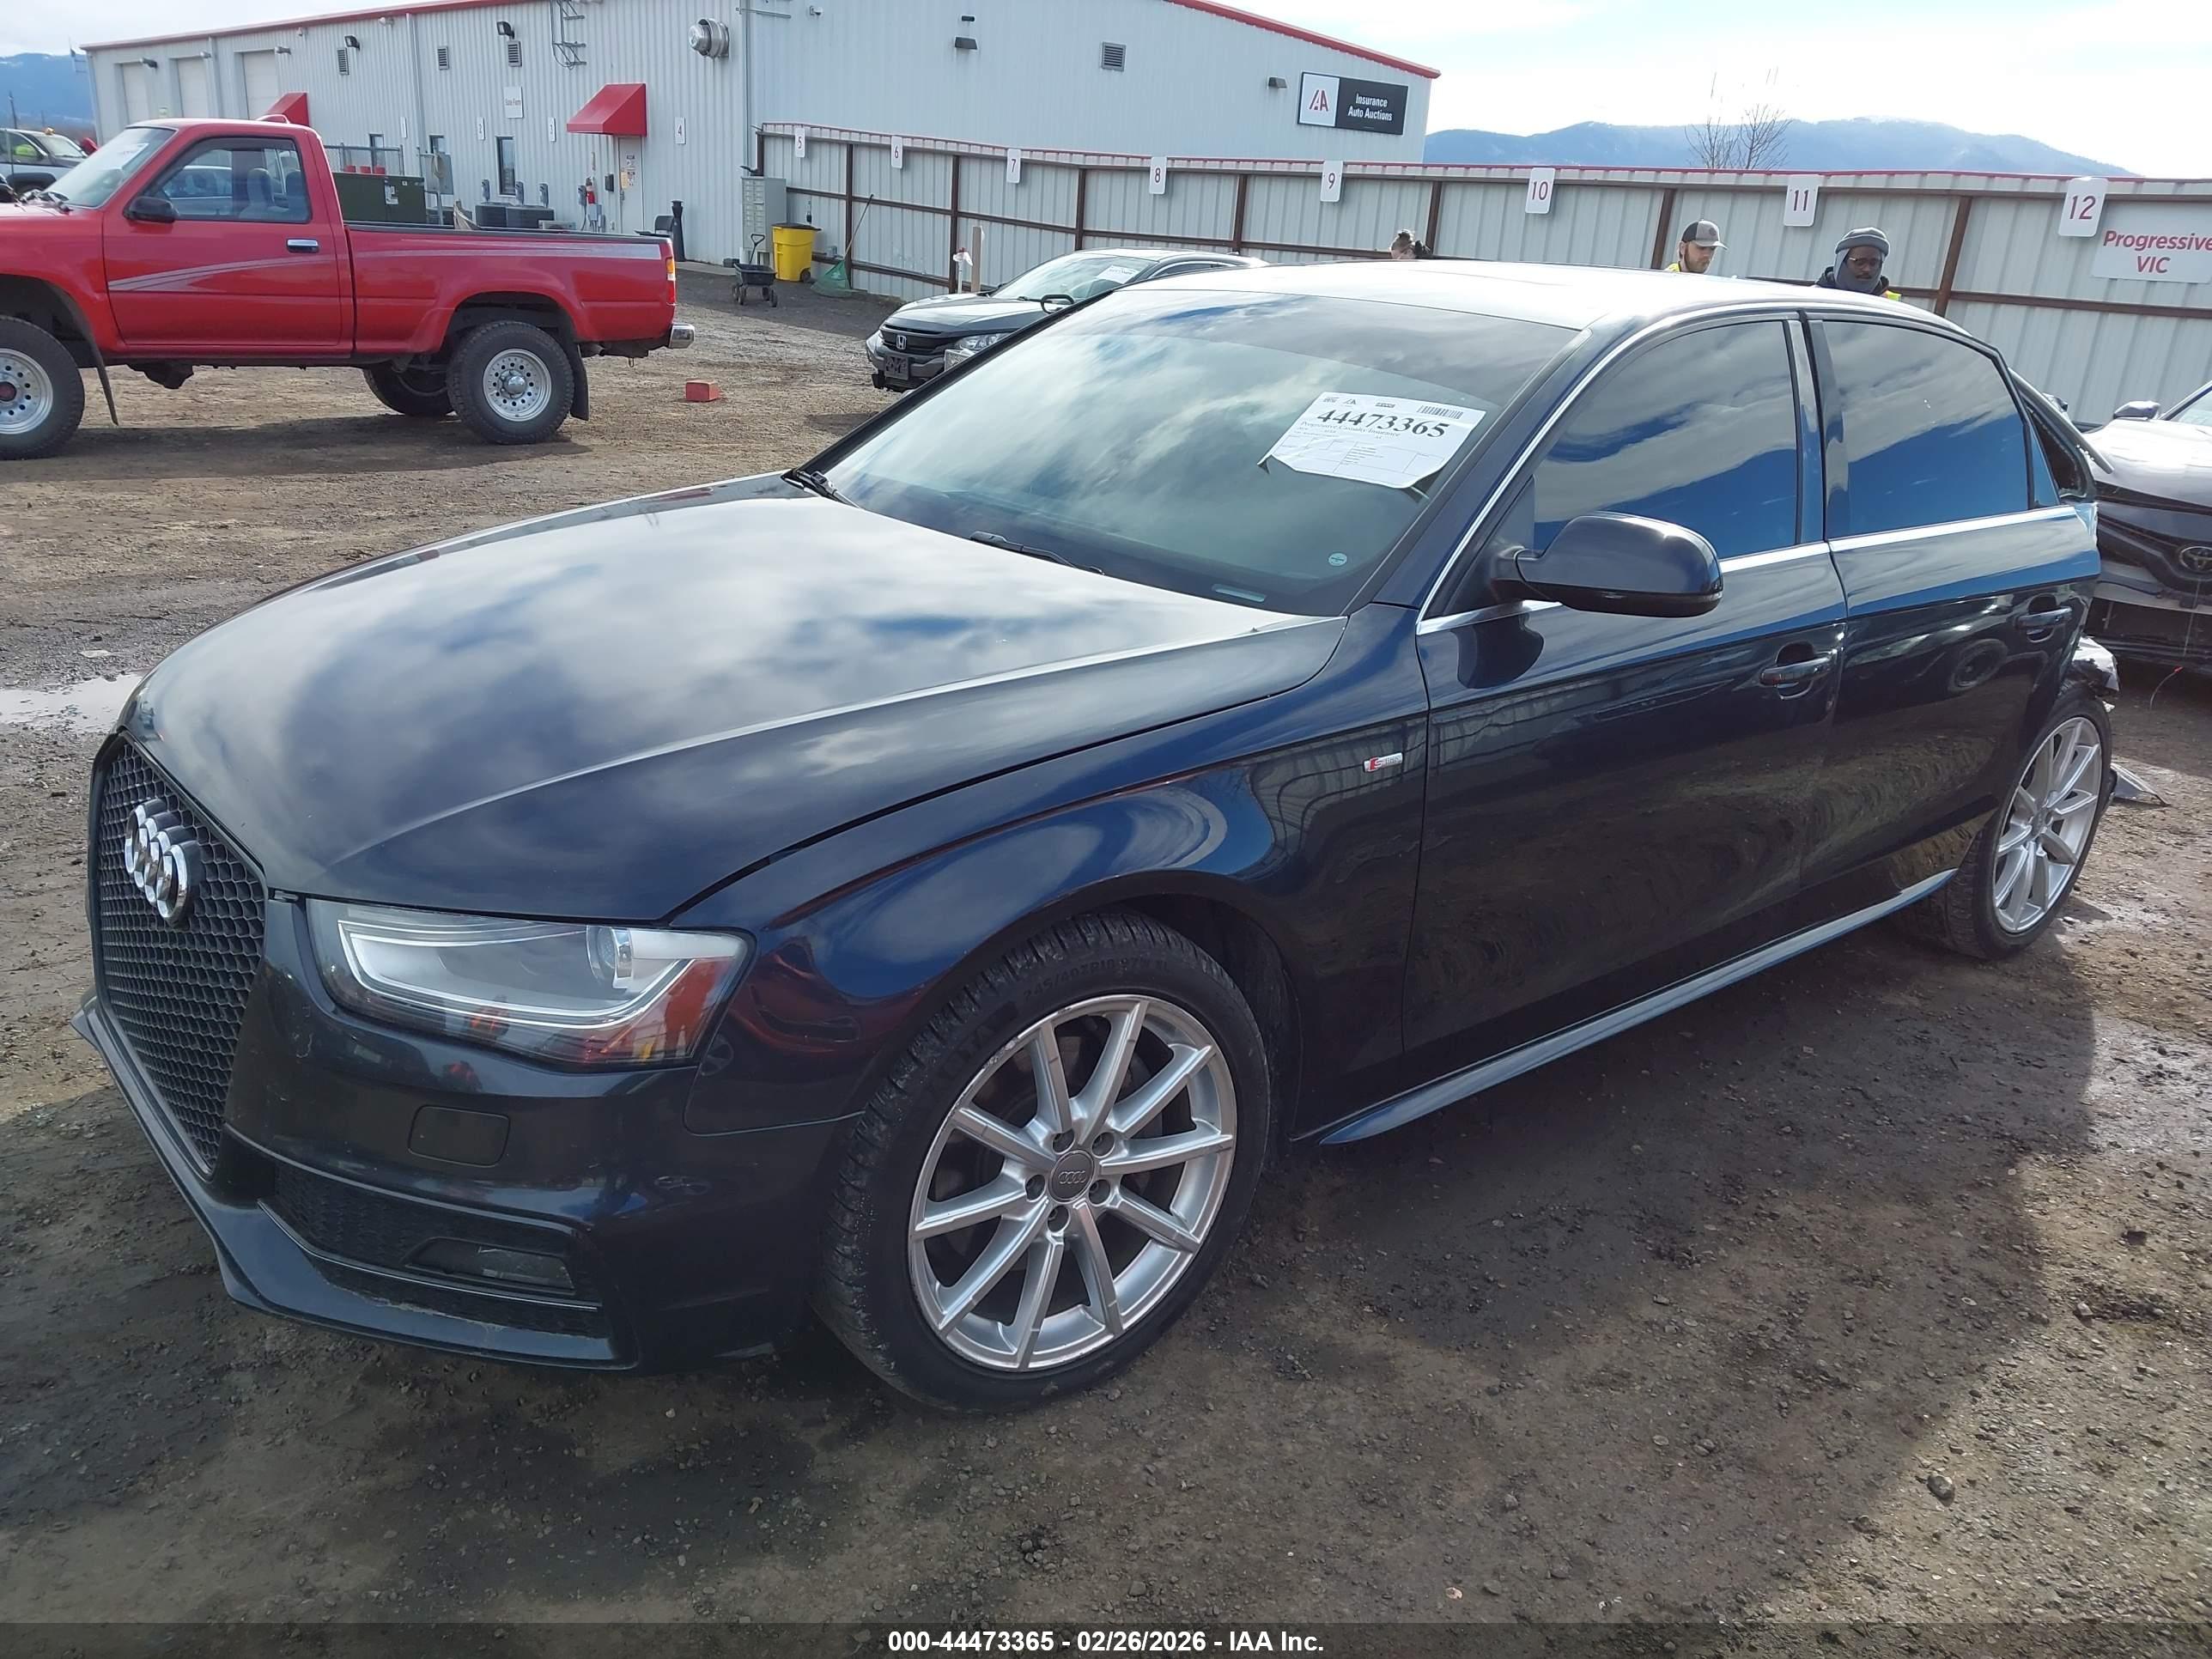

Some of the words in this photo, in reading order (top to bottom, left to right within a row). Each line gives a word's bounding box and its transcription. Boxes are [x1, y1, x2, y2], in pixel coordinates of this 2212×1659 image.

[1355, 94, 1388, 108] Insurance
[1348, 106, 1364, 118] Auto
[1364, 108, 1392, 121] Auctions
[678, 125, 682, 136] 4
[798, 137, 802, 149] 5
[894, 145, 899, 159] 6
[1011, 159, 1017, 173] 7
[1154, 167, 1161, 183] 8
[1328, 173, 1336, 189] 9
[1532, 181, 1549, 200] 10
[1794, 190, 1808, 211] 11
[2069, 195, 2096, 220] 12
[2136, 255, 2171, 274] VIC
[1316, 410, 1449, 437] 44473365
